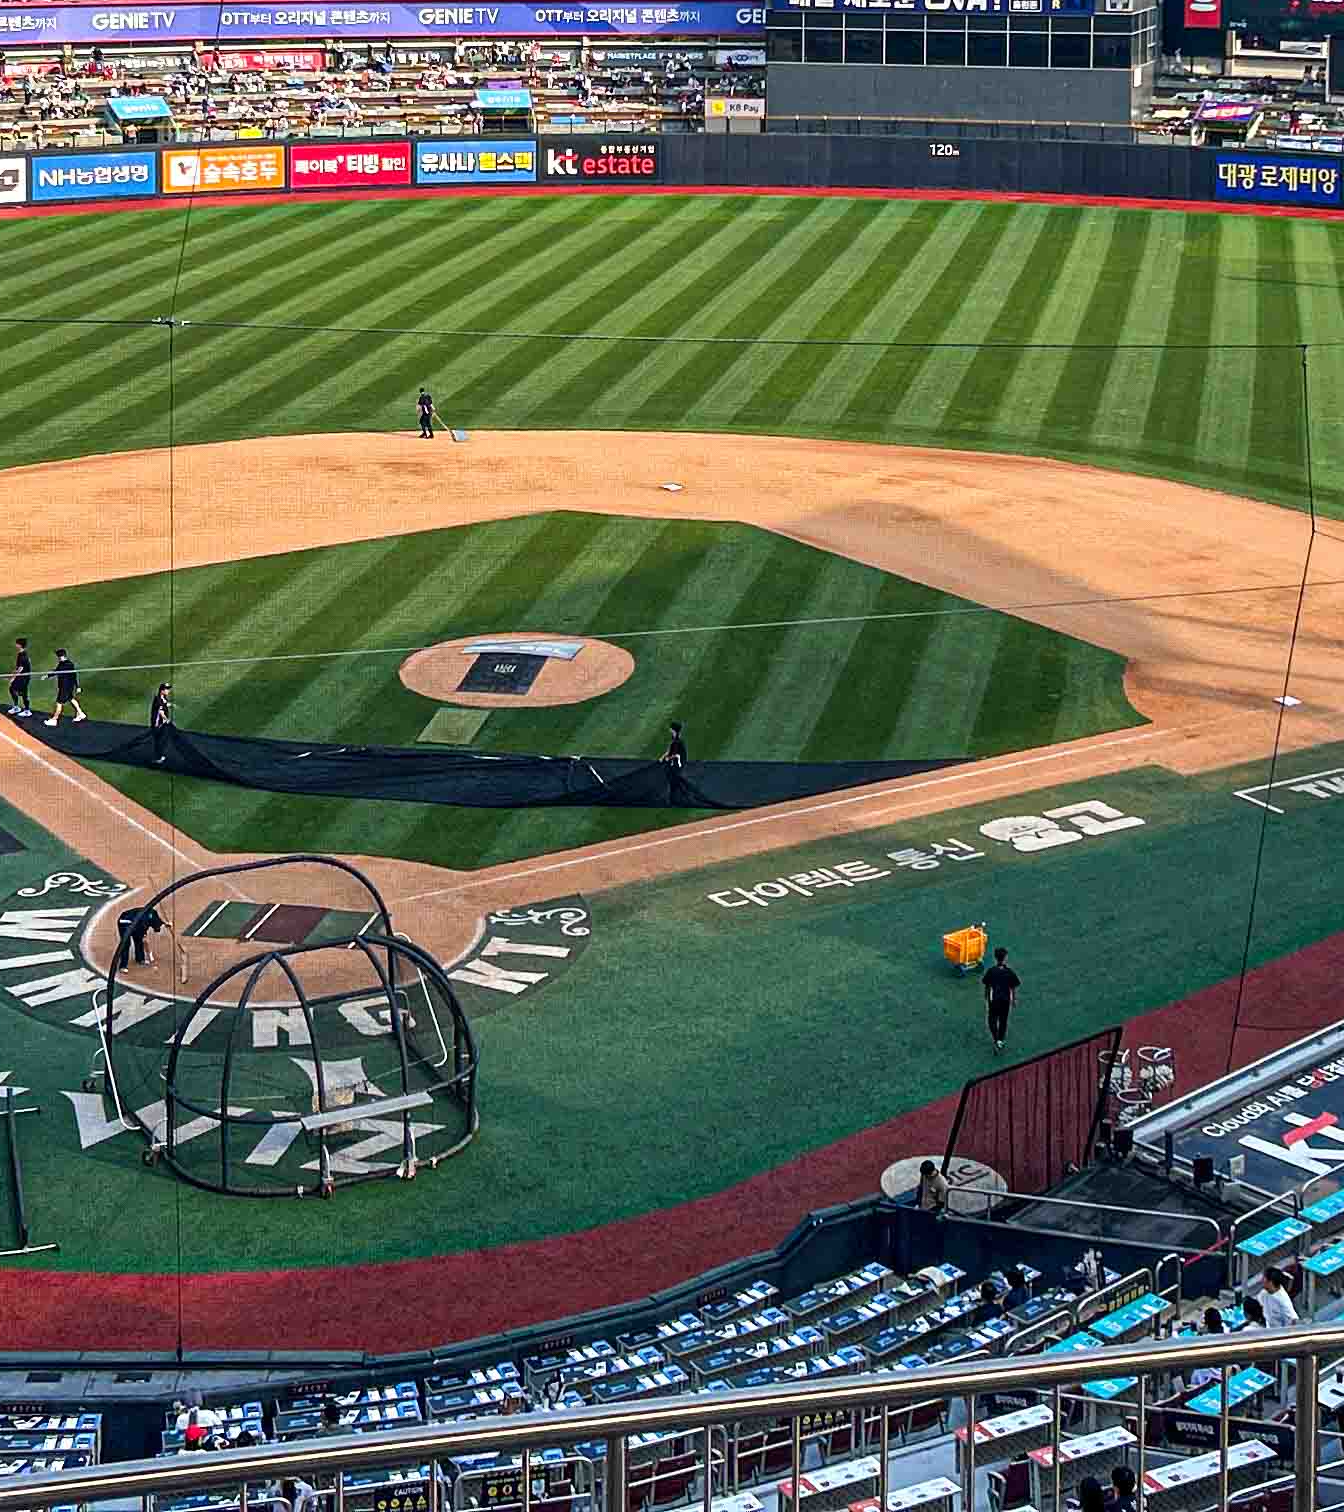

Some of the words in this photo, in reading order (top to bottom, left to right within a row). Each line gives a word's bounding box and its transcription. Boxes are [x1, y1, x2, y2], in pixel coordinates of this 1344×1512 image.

[92, 12, 149, 31] GENIE
[150, 11, 175, 30] TV
[221, 10, 272, 27] OTT부터
[275, 9, 328, 27] 오리지널
[329, 7, 391, 26] 콘텐츠까지
[418, 7, 473, 26] GENIE
[474, 7, 499, 25] TV
[535, 8, 585, 24] OTT부터
[586, 7, 637, 25] 오리지널
[640, 7, 701, 25] 콘텐츠까지
[346, 154, 379, 174] 티빙
[381, 156, 406, 172] 할인
[420, 152, 476, 173] 유사나
[478, 151, 533, 172] 헬스팩
[547, 149, 579, 176] kt
[582, 155, 655, 176] estate
[38, 163, 149, 187] NH농협생명
[1218, 162, 1258, 189] 대광
[1259, 165, 1338, 194] 로제비앙
[705, 859, 892, 909] 다이렉트
[886, 835, 986, 872] 통신
[1200, 1094, 1272, 1139] Cloud와
[1269, 1083, 1309, 1110] AI를
